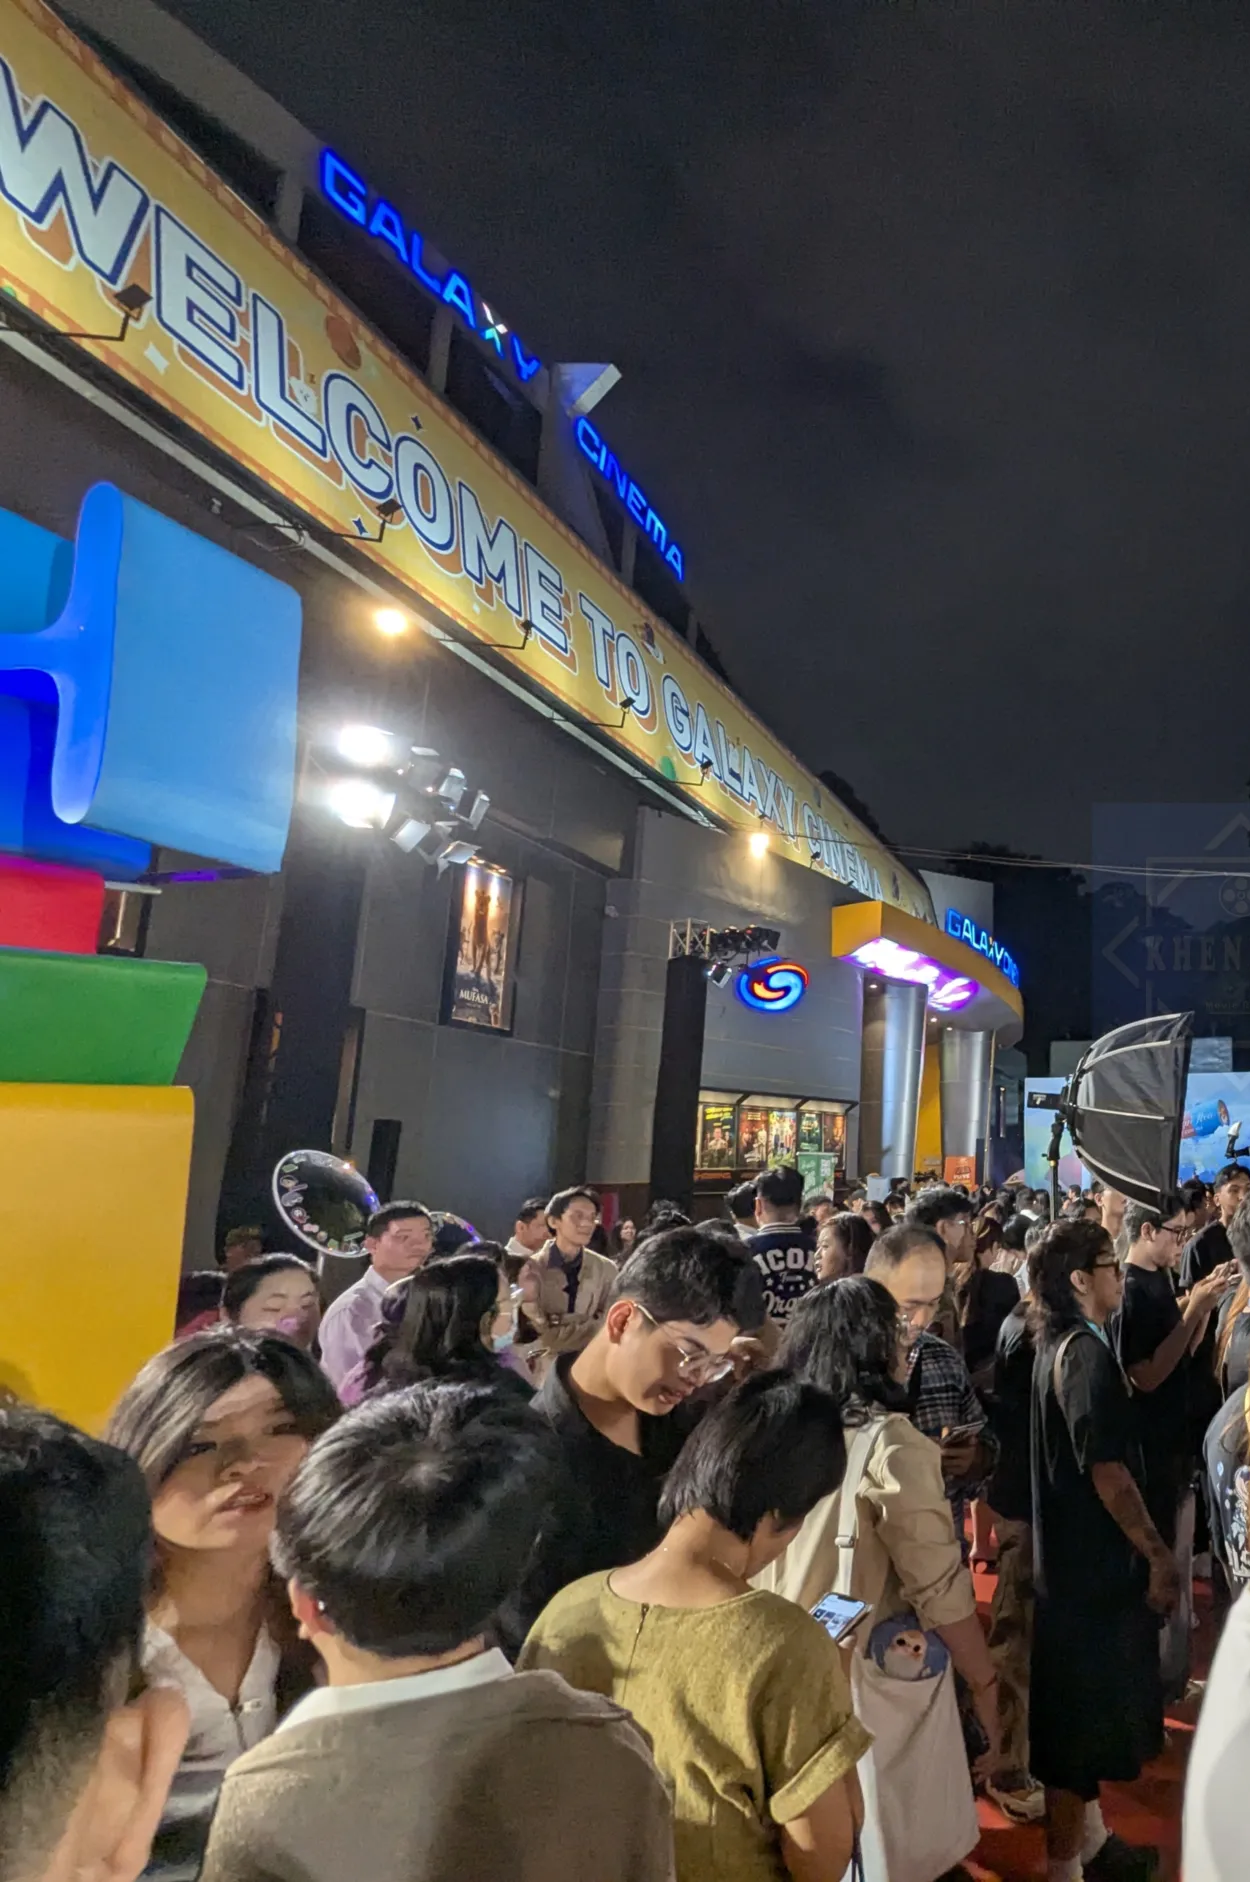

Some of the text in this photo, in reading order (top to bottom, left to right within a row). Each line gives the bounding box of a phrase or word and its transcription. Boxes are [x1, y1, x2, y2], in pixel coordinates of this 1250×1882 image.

[0, 57, 884, 901] WELCOME TO GALAXY CINEMA
[321, 147, 686, 582] GALAXY CINEMA
[459, 988, 489, 1005] MUFASA
